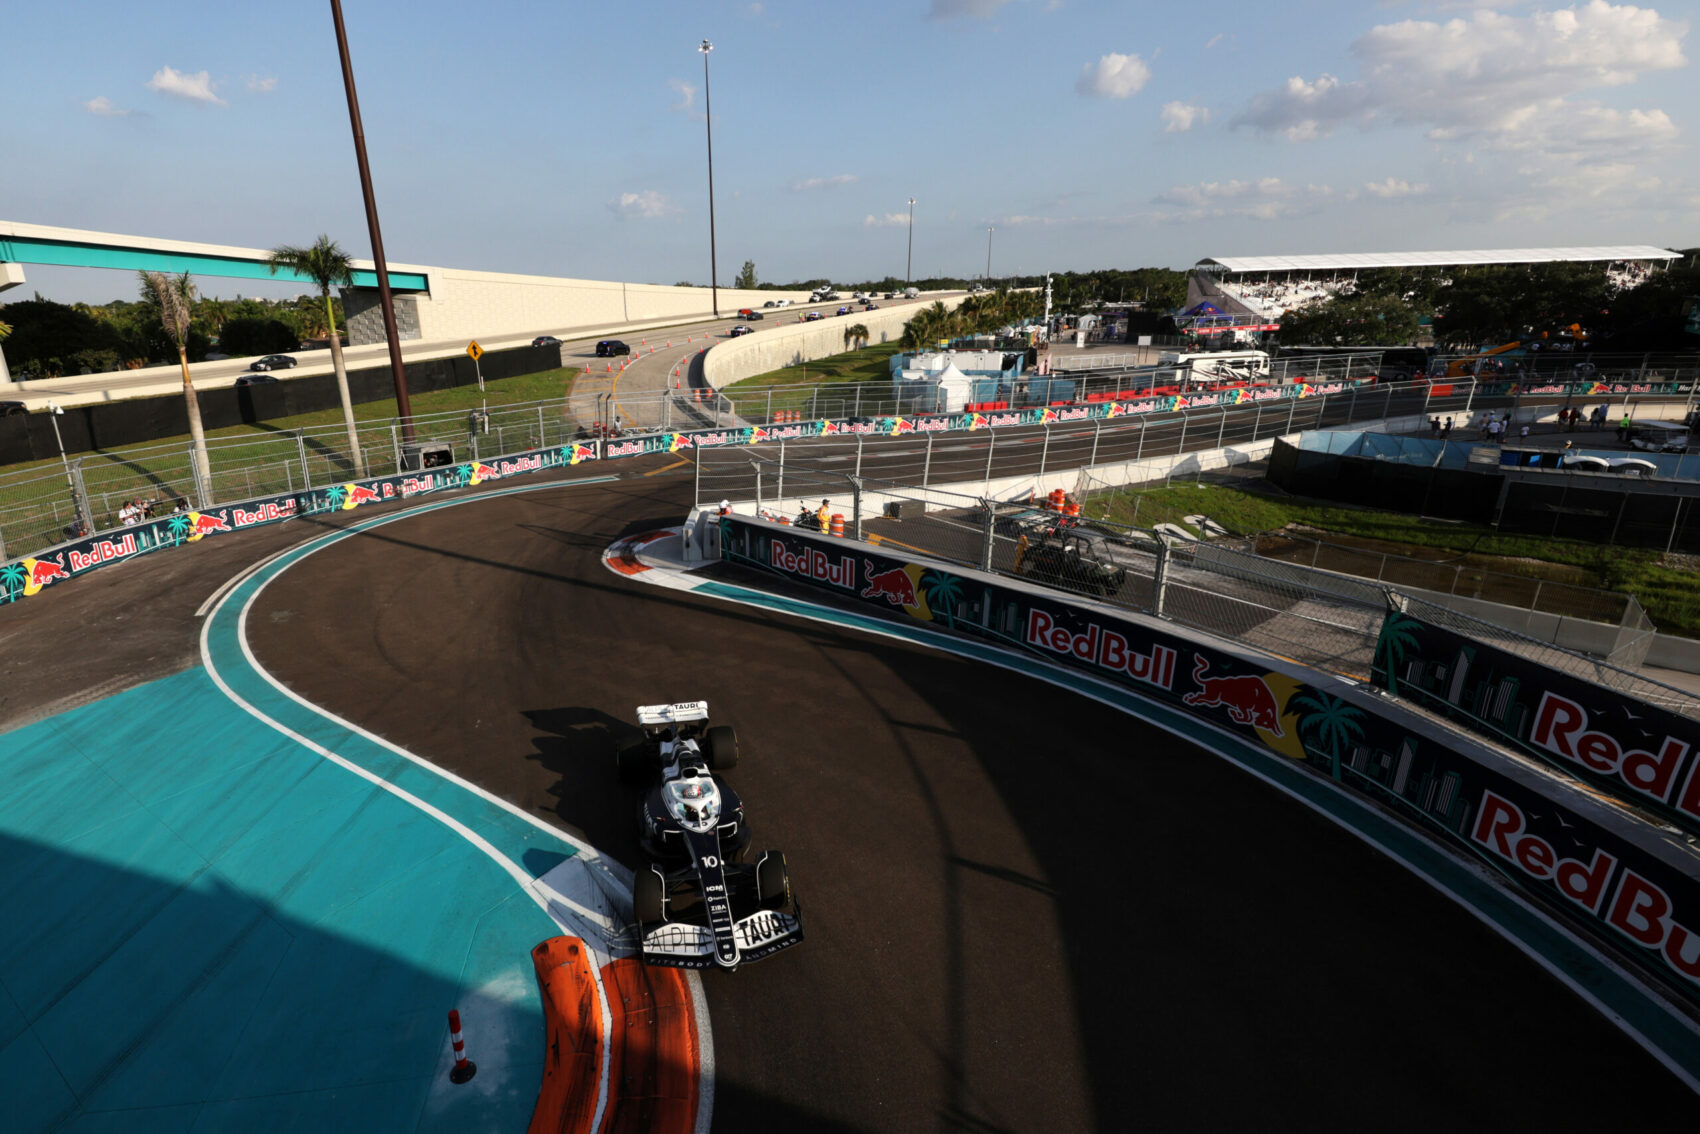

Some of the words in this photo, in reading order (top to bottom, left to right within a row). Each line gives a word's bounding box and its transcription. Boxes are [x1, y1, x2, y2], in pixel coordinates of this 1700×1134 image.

[991, 414, 1005, 425] Red
[1005, 412, 1020, 424] Bull
[1060, 410, 1074, 420] Red
[1074, 407, 1088, 419] Bull
[856, 422, 874, 432] Bull
[932, 418, 948, 430] Bull
[710, 432, 726, 444] Bull
[608, 442, 626, 456] Red
[626, 440, 644, 454] Bull
[501, 460, 522, 475] Red
[522, 455, 542, 470] Bull
[410, 474, 433, 492] Bull
[233, 503, 266, 527] Red
[266, 499, 296, 522] Bull
[68, 543, 100, 572] Red
[100, 534, 136, 560] Bull
[770, 539, 811, 577] Red
[812, 553, 856, 591] Bull
[1027, 608, 1099, 664] Red
[1099, 628, 1176, 691] Bull
[674, 702, 698, 710] TAURI
[1530, 691, 1689, 804] Red
[1471, 789, 1618, 916] Red
[701, 856, 718, 868] 10
[651, 927, 708, 952] ALPHA
[739, 912, 790, 946] TAURI
